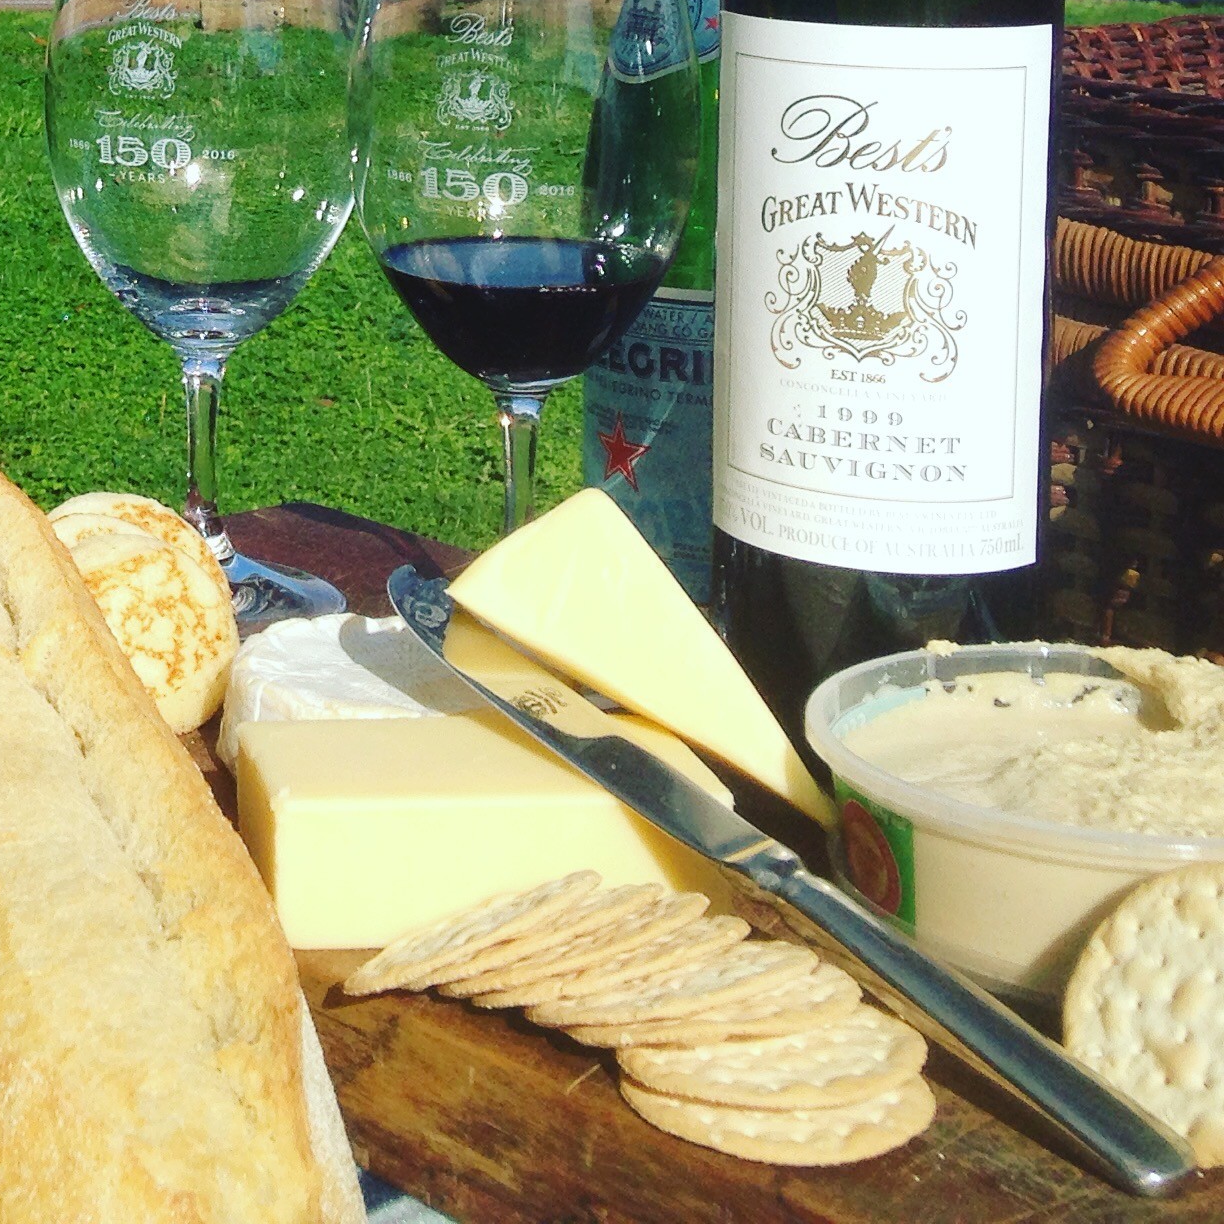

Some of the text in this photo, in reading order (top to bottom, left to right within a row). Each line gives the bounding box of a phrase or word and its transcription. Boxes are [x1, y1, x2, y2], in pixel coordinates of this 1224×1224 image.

[108, 22, 183, 49] GREAT WESTERN
[445, 13, 515, 47] Best's
[436, 52, 469, 69] GREAT
[95, 109, 202, 143] Celebrating
[771, 95, 953, 172] Best's
[96, 135, 192, 168] 150
[202, 150, 236, 161] 2016
[418, 140, 541, 176] Celebrating
[120, 170, 166, 183] YEARS
[421, 167, 528, 207] 150
[539, 185, 575, 196] 2016
[761, 182, 977, 250] GREAT WESTERN
[831, 369, 886, 384] EST 1866
[817, 404, 903, 426] 1999
[767, 418, 961, 454] CABERNET
[759, 442, 967, 482] SAUVIGNON
[779, 524, 851, 552] PRODUCE
[856, 538, 878, 554] OF
